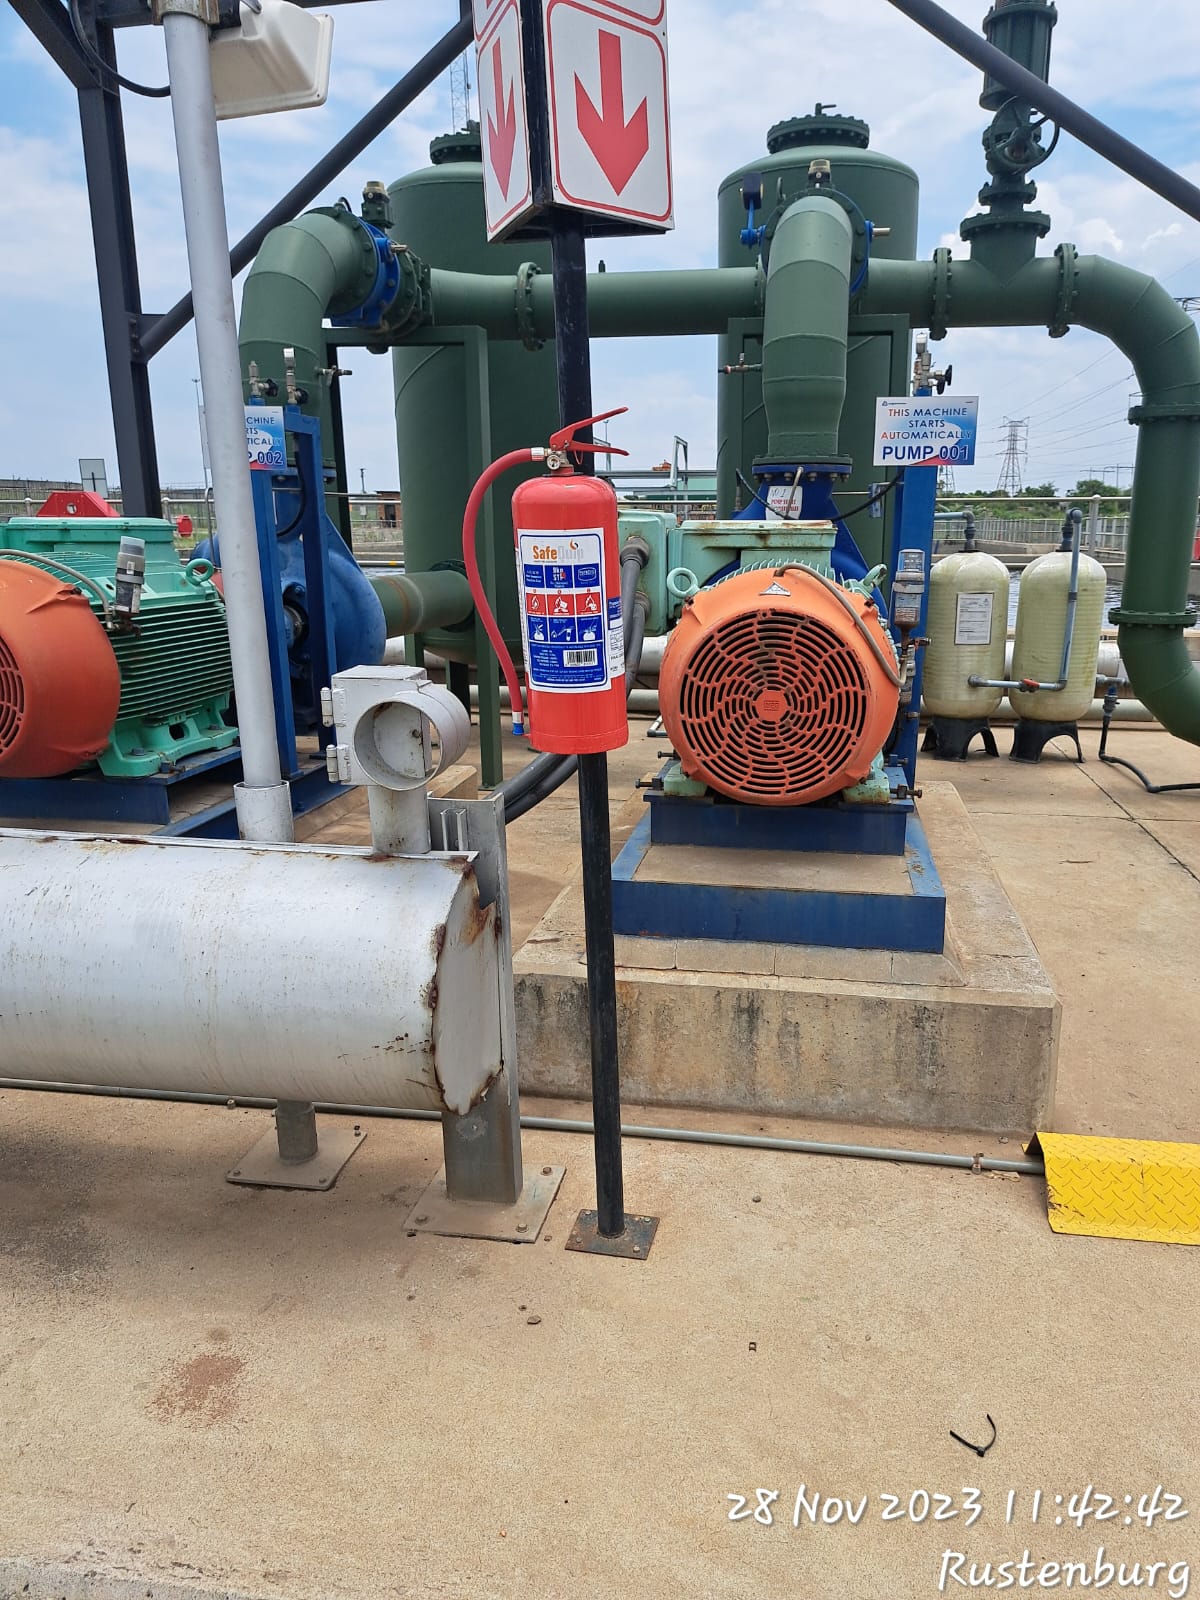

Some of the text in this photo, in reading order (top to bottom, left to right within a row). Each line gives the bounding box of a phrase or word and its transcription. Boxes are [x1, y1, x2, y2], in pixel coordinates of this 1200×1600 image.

[888, 407, 967, 417] THIS MACHINE
[246, 416, 275, 425] CHINE
[908, 419, 945, 428] STARTS
[880, 430, 972, 440] AUTOMATICALLY
[257, 450, 283, 465] 002
[882, 444, 969, 461] PUMP 001
[533, 541, 584, 560] SafeQuip
